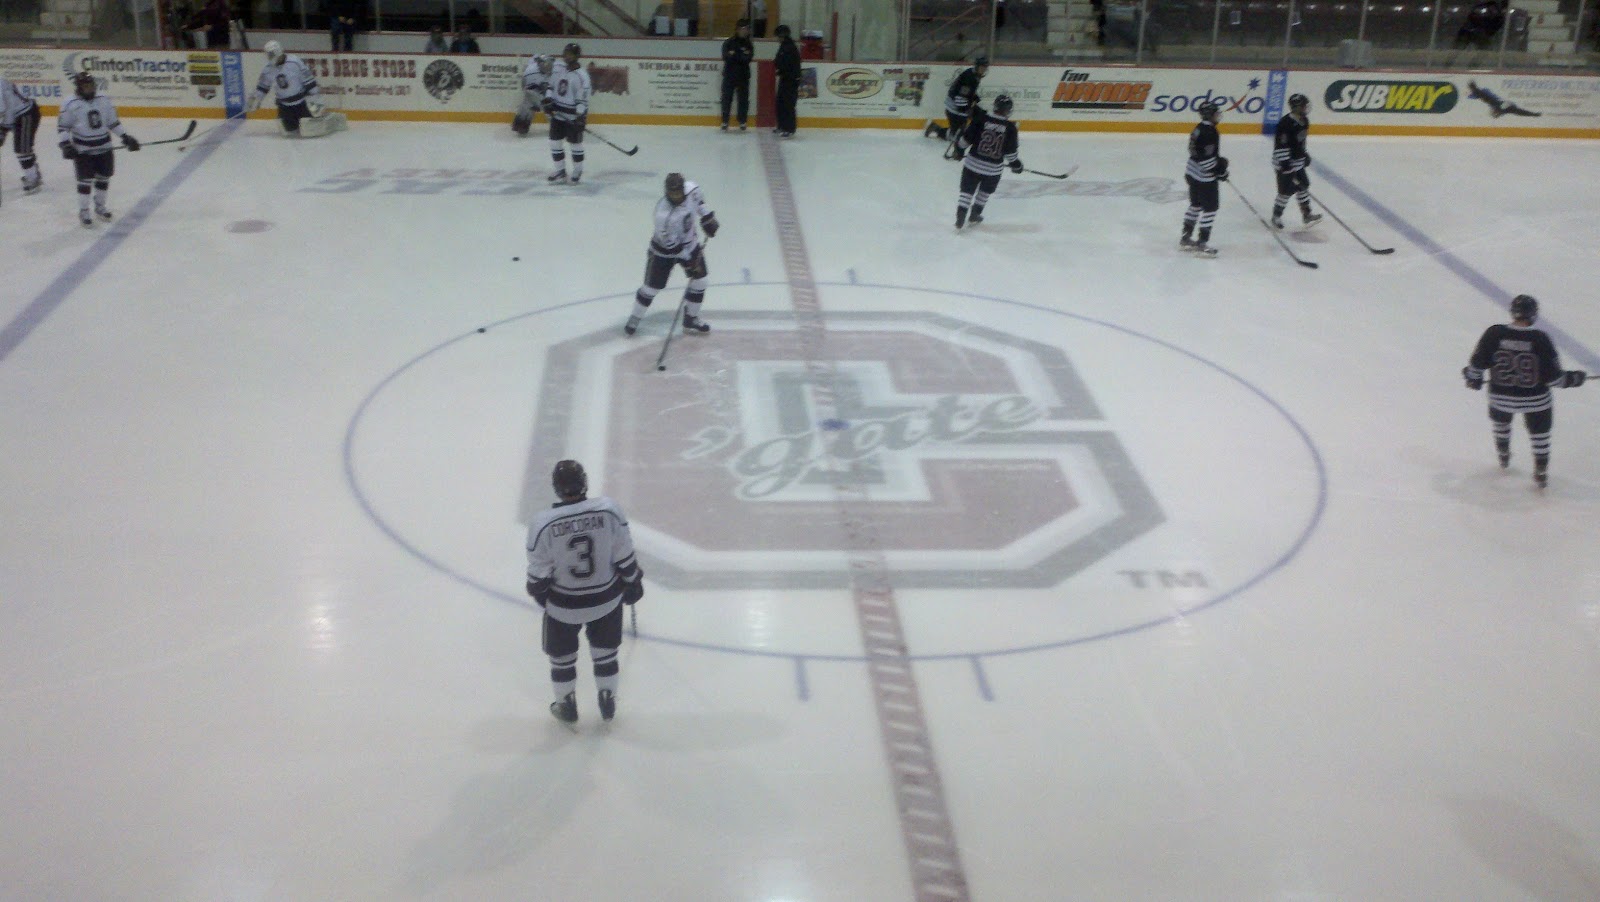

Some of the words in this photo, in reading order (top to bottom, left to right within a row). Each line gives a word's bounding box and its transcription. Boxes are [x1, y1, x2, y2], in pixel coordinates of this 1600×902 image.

[81, 57, 187, 73] ClintonTractor
[333, 59, 369, 78] DRUG
[372, 59, 417, 79] STORE
[638, 62, 682, 72] NICHOLS
[1060, 69, 1090, 83] fan
[22, 85, 61, 97] BLUE
[1150, 89, 1265, 114] sodexo
[1330, 83, 1453, 111] SUBWAY
[1490, 349, 1541, 388] 29
[551, 514, 606, 538] CORCORAN
[568, 532, 595, 580] 3
[1115, 569, 1209, 590] TM
